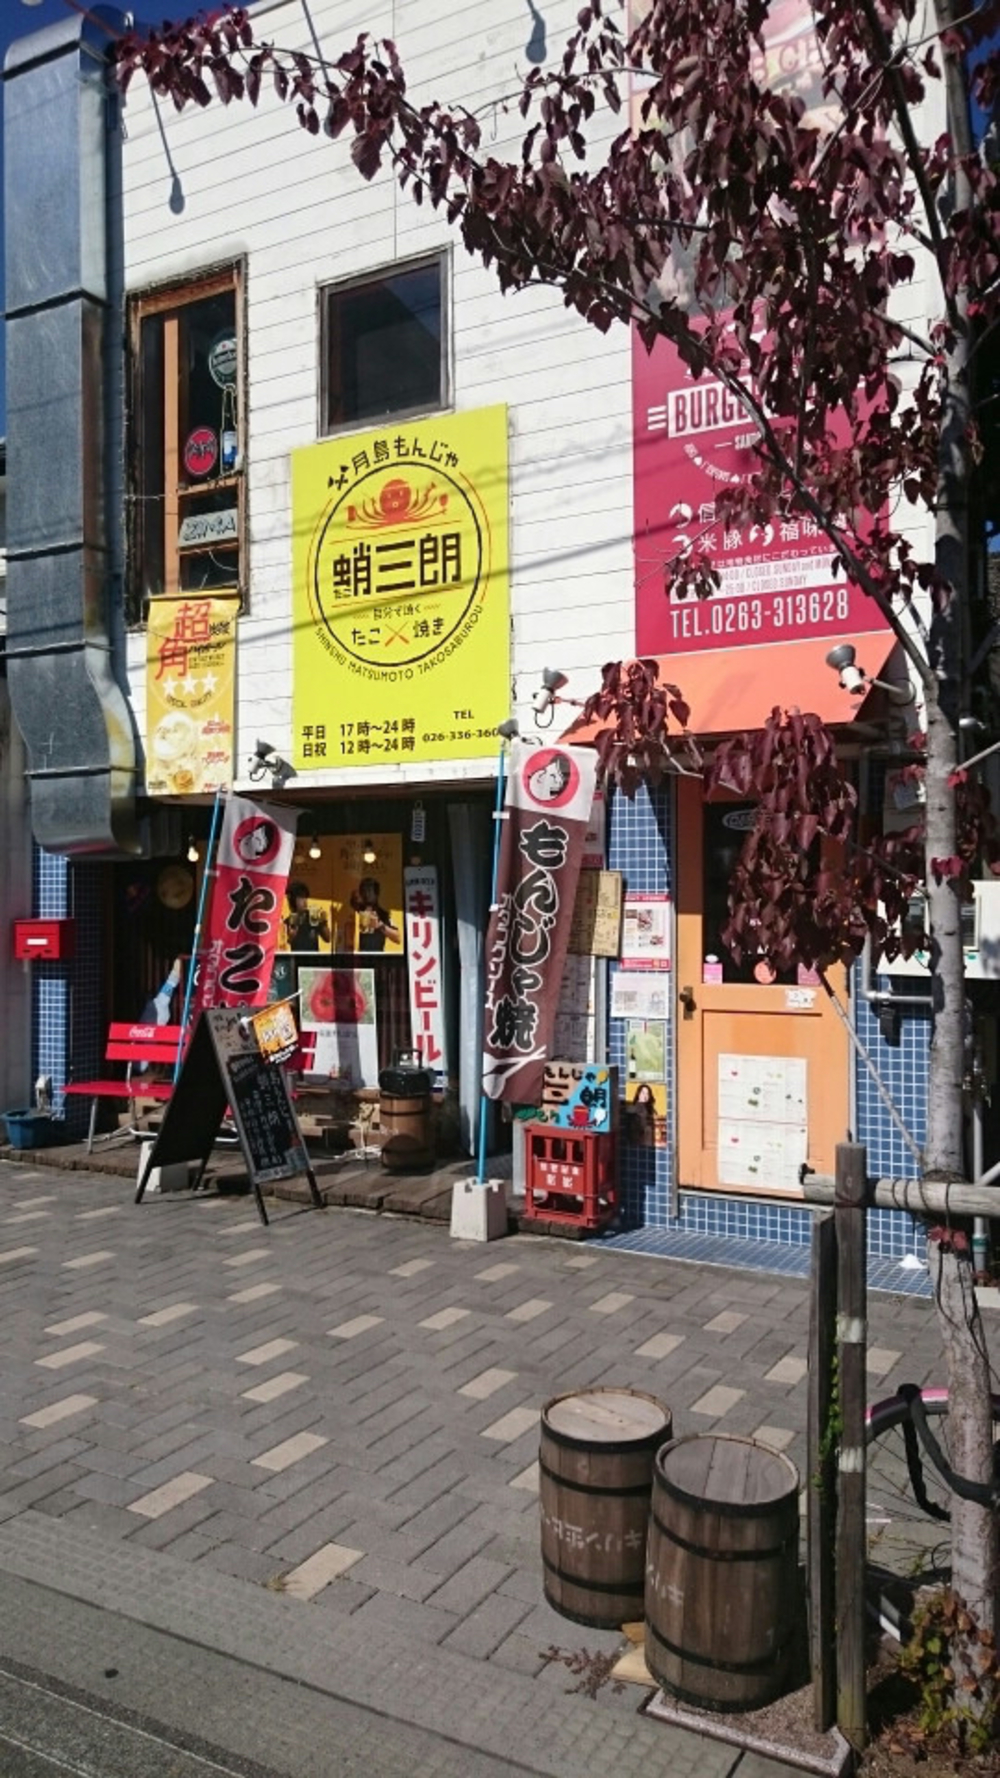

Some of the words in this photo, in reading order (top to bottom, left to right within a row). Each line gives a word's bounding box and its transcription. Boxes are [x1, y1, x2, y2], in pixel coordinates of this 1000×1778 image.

[675, 385, 758, 432] BURGE
[352, 435, 459, 475] 月島もんじゃ
[333, 533, 461, 596] 蛸三朗
[352, 628, 380, 646] たこ
[413, 617, 444, 638] 焼き
[670, 589, 848, 638] TEL.0263-313628
[347, 659, 414, 682] MATSUMOTO
[418, 604, 484, 675] TAKOSABUROU
[302, 725, 326, 740] 平日
[422, 728, 500, 742] 026-336-360
[453, 710, 474, 720] TEL
[302, 742, 327, 758] 日祝
[219, 875, 278, 1007] たこ
[488, 818, 569, 1053] もんじゃ焼
[408, 889, 442, 1062] キリンビール
